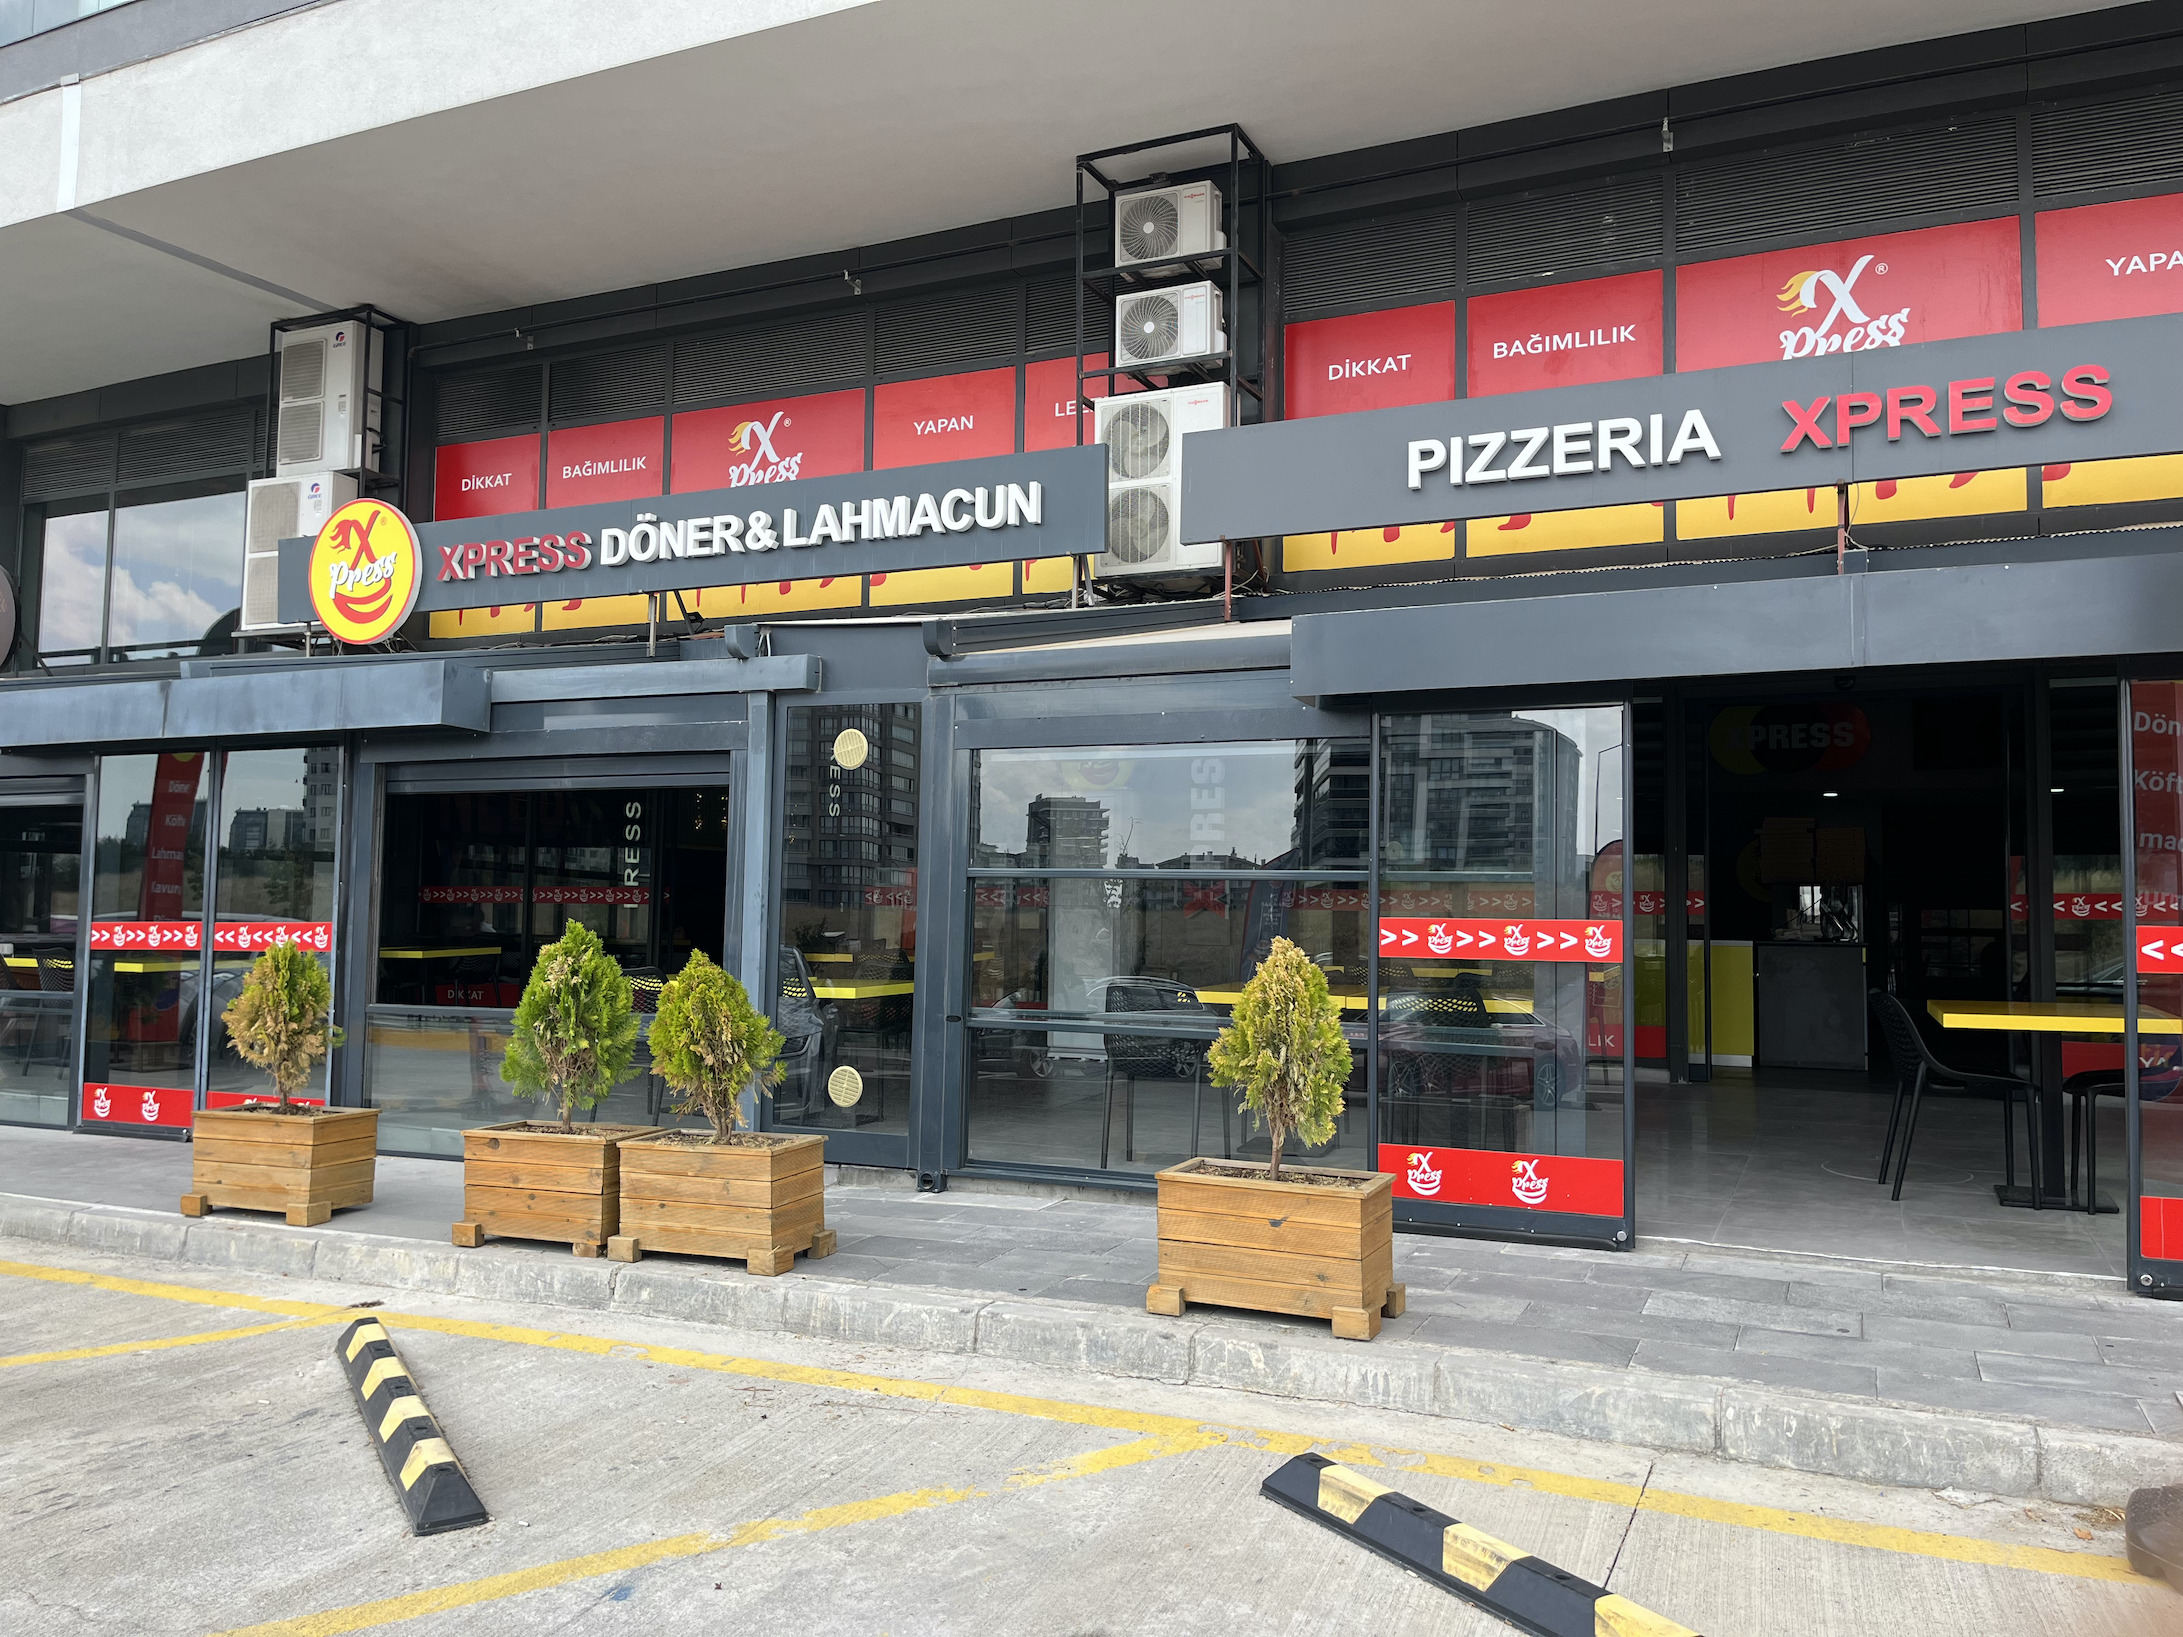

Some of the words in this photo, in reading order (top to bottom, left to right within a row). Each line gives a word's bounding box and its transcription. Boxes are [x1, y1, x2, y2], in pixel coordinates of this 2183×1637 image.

[1493, 324, 1636, 359] BAĞIMLILIK
[1328, 354, 1412, 381] DİKKAT
[913, 415, 974, 436] YAPAN
[1407, 408, 1722, 490] PIZZERIA
[1780, 364, 2113, 453] XPRESS
[562, 456, 647, 479] BAĞIMLILIK
[461, 473, 512, 492] DİKKAT
[436, 531, 593, 582] XPRESS
[783, 480, 1042, 548] LAHMACUN
